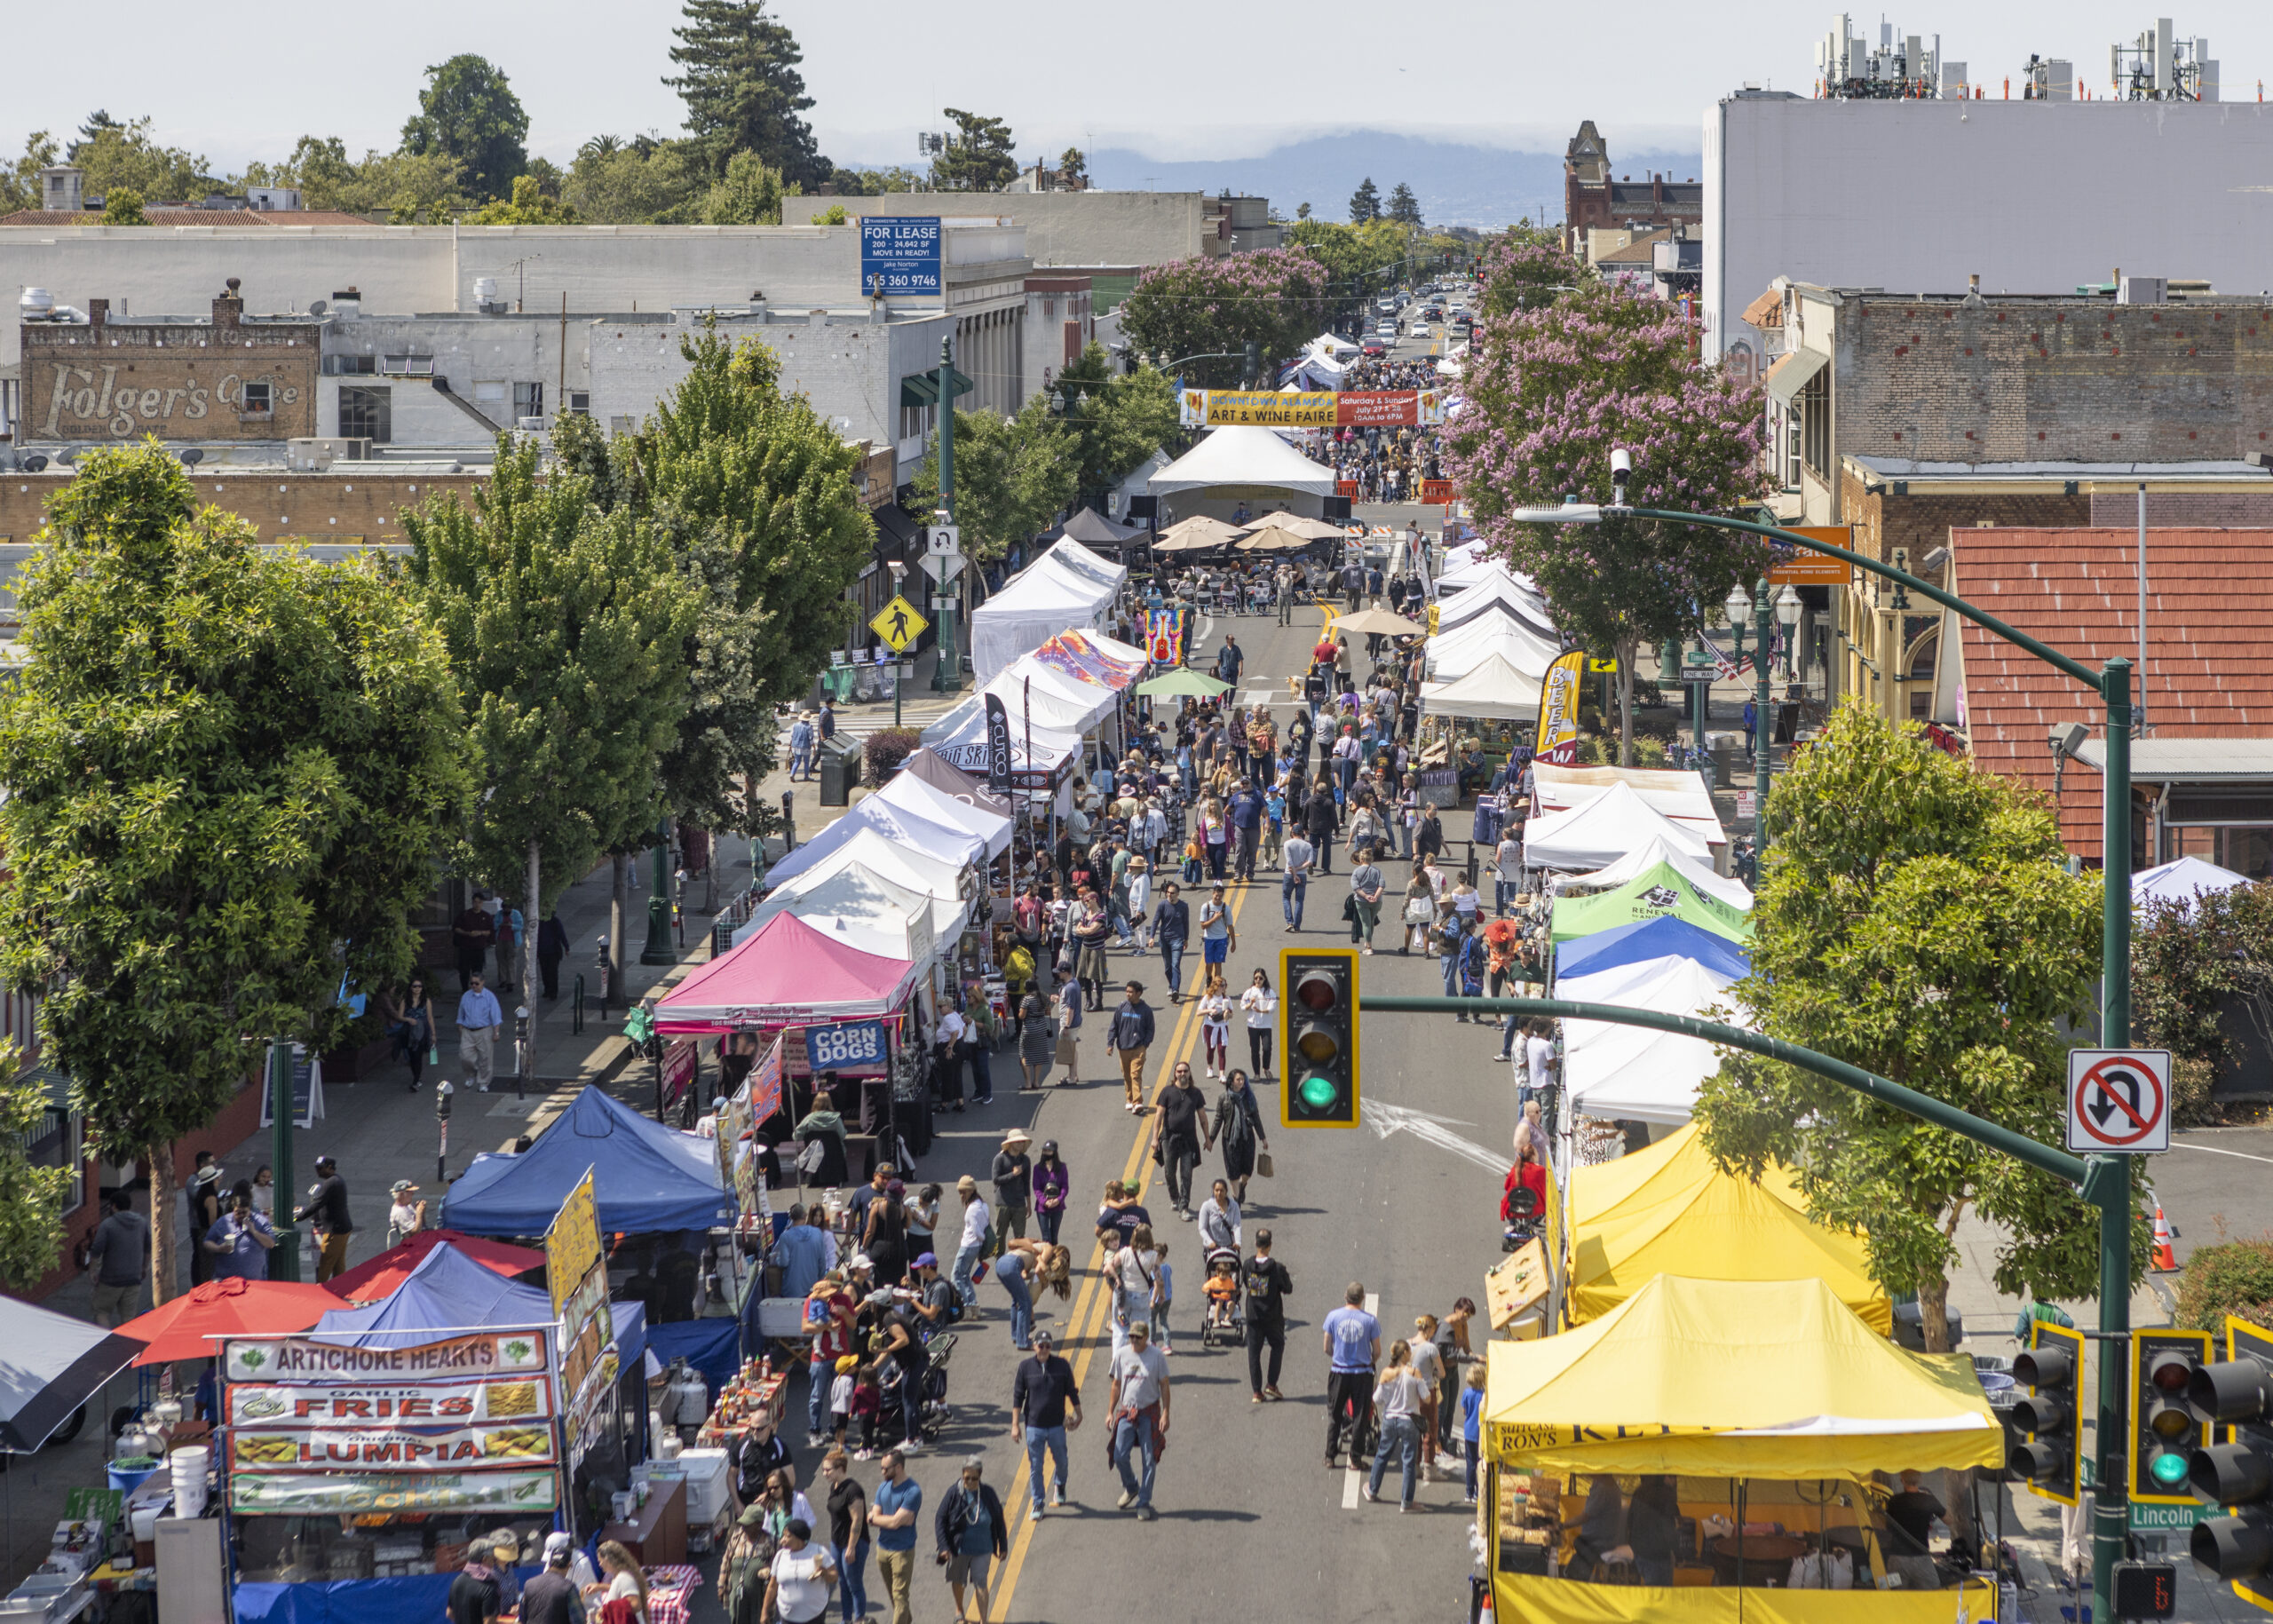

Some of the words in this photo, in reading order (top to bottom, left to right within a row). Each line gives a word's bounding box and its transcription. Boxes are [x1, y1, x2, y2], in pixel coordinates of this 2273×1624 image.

[864, 227, 891, 239] FOR
[895, 227, 938, 239] LEASE
[889, 274, 908, 286] 360
[911, 274, 937, 286] 9746
[36, 360, 210, 439] Folger's
[1210, 396, 1279, 407] DOWNTOWN
[1281, 397, 1334, 407] ALAMEDA
[1340, 397, 1375, 406] Saturday
[1210, 409, 1236, 422] ART
[1240, 410, 1249, 422] &
[1255, 410, 1291, 422] WINE
[1295, 411, 1334, 423] FAIRE
[62, 424, 107, 434] GOLDEN
[137, 424, 168, 434] GATE
[1544, 666, 1565, 745] BEER
[994, 725, 1007, 776] CUTCO
[1632, 907, 1683, 920] RENEWAL
[815, 1027, 876, 1047] CORN
[817, 1042, 877, 1064] DOGS
[276, 1347, 404, 1371] ARTICHOKE
[410, 1343, 494, 1370] HEARTS
[329, 1389, 421, 1398] GARLIC
[294, 1397, 475, 1418] FRIES
[299, 1439, 486, 1462] LUMPIA
[1501, 1431, 1557, 1452] RON'S
[2134, 1505, 2194, 1525] Lincoln
